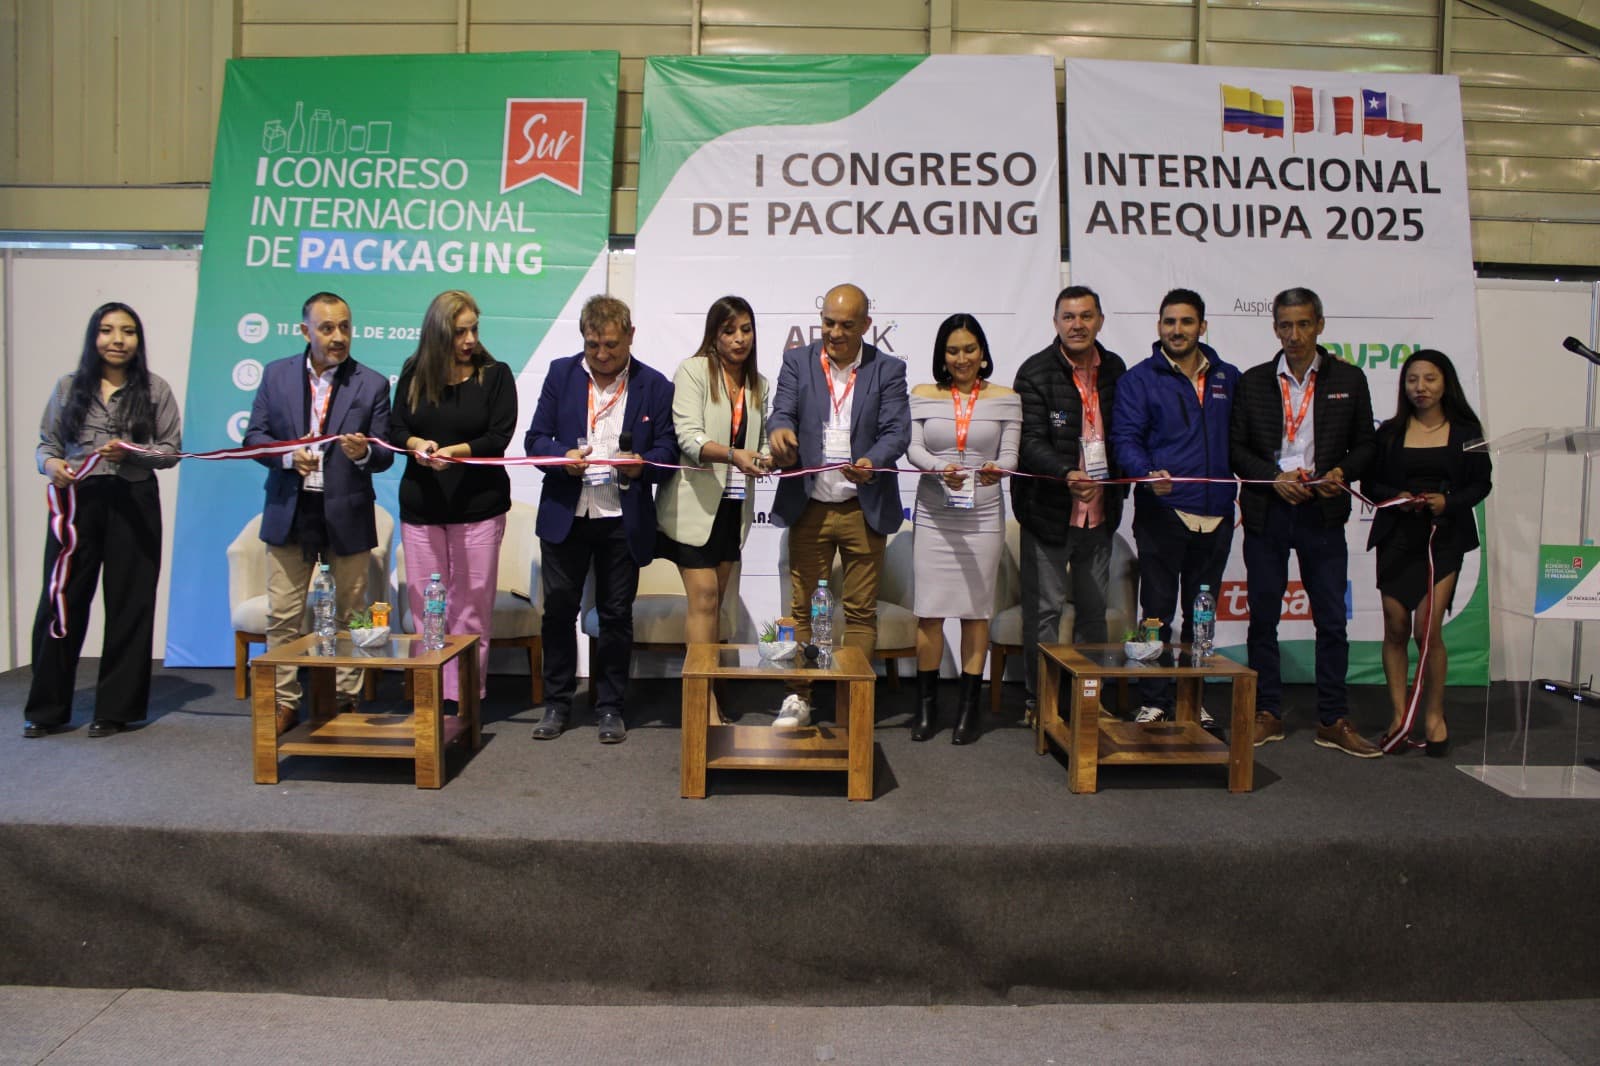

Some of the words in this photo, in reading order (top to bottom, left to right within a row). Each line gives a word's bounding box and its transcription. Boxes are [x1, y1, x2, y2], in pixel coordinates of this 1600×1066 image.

[515, 113, 575, 166] Sur
[255, 156, 269, 187] I
[272, 156, 469, 190] CONGRESO
[755, 153, 764, 188] I
[782, 151, 1037, 187] CONGRESO
[1083, 151, 1441, 195] INTERNACIONAL
[250, 196, 536, 233] INTERNACIONAL
[692, 202, 749, 236] DE
[767, 200, 1038, 236] PACKAGING
[1085, 200, 1312, 243] AREQUIPA
[1326, 206, 1425, 242] 2025
[245, 236, 294, 268] DE
[299, 238, 544, 275] PACKAGING
[1233, 297, 1274, 317] Auspic
[364, 326, 384, 339] DE
